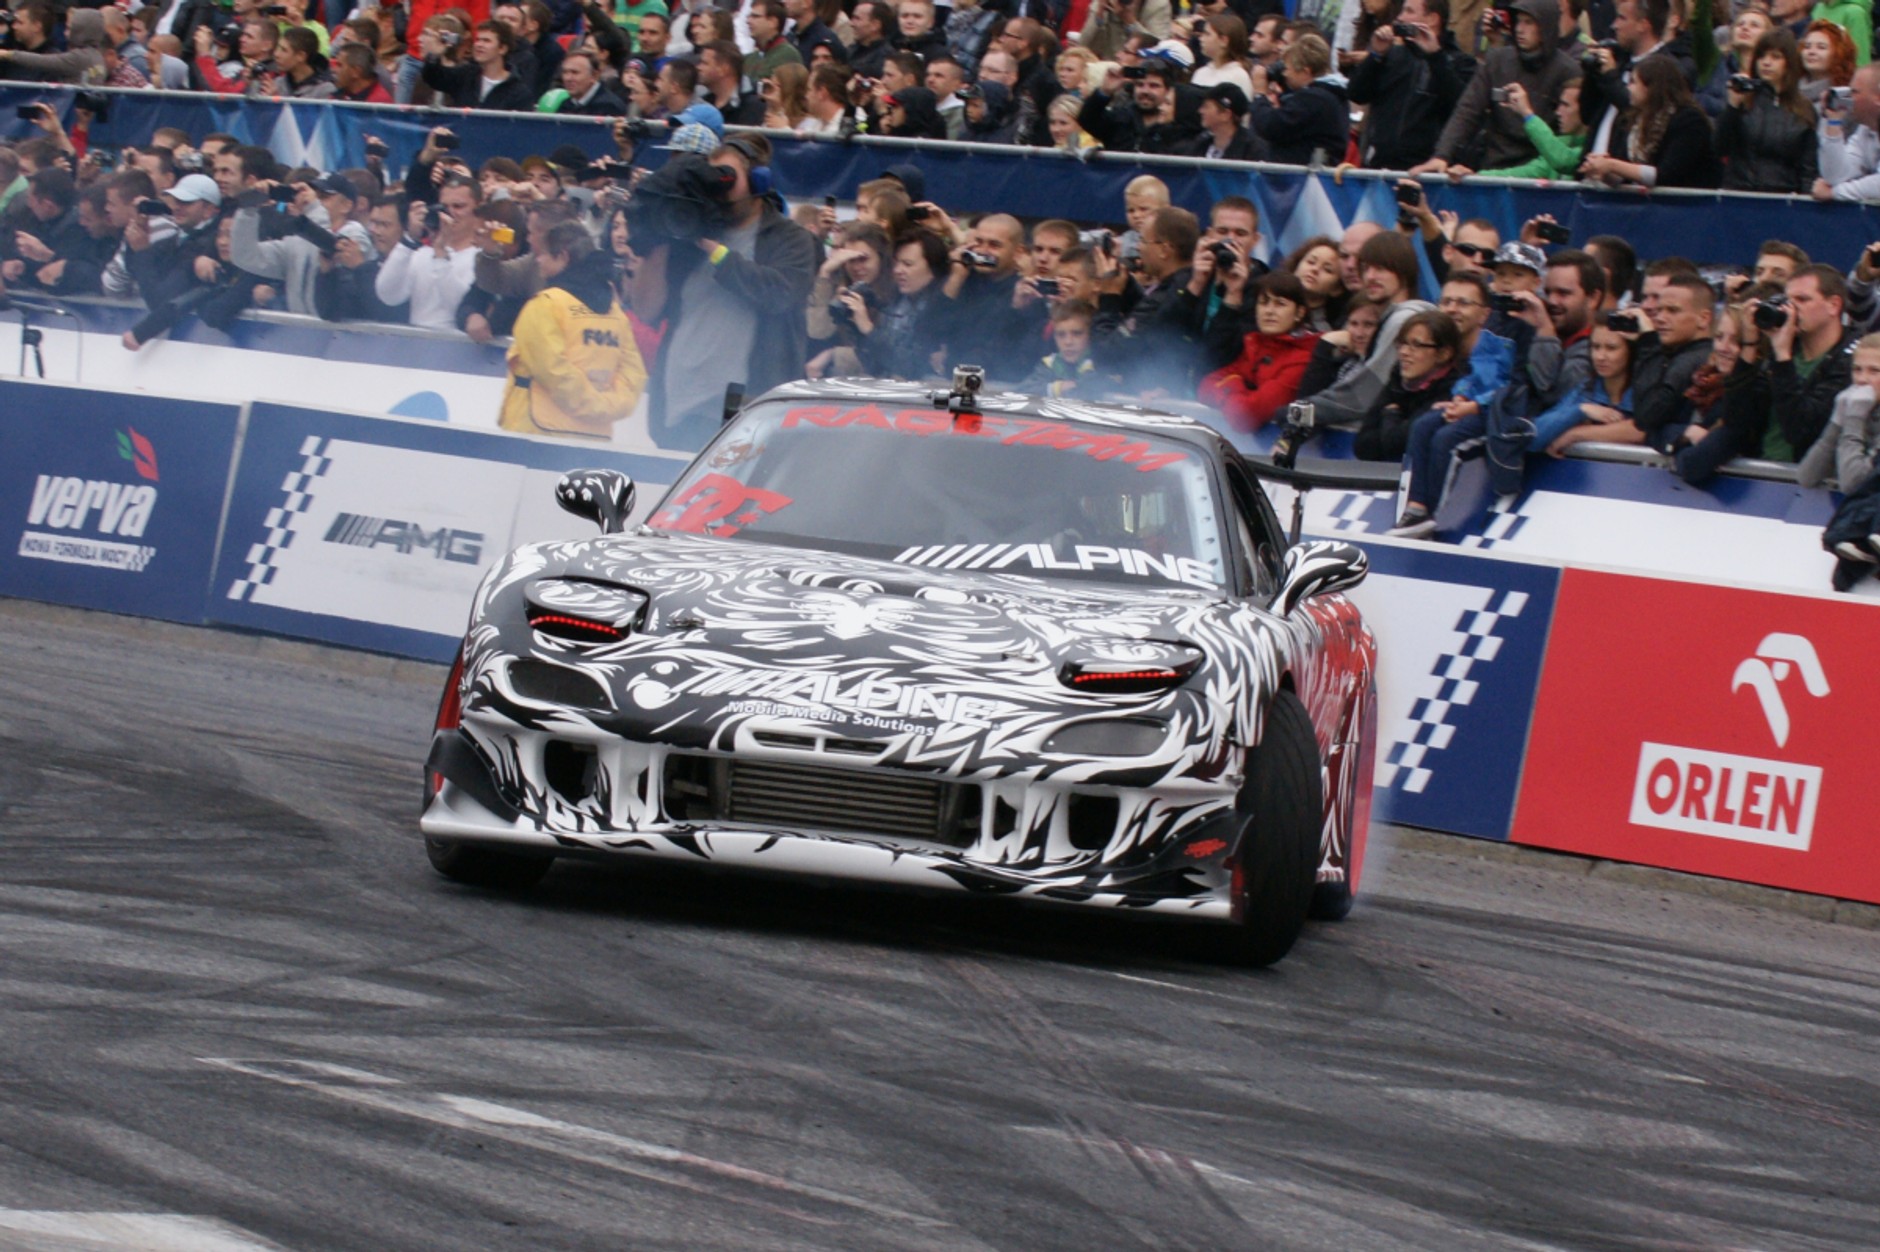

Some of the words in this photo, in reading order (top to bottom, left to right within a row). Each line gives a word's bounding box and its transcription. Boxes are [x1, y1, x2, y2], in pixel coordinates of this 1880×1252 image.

[27, 474, 158, 537] verva
[369, 518, 485, 565] AMG
[988, 543, 1219, 591] ALPINE
[726, 701, 789, 716] Mobile
[792, 703, 848, 723] Media
[852, 713, 936, 737] Solutions
[774, 671, 994, 729] ALPINE
[1645, 756, 1807, 836] ORLEN
